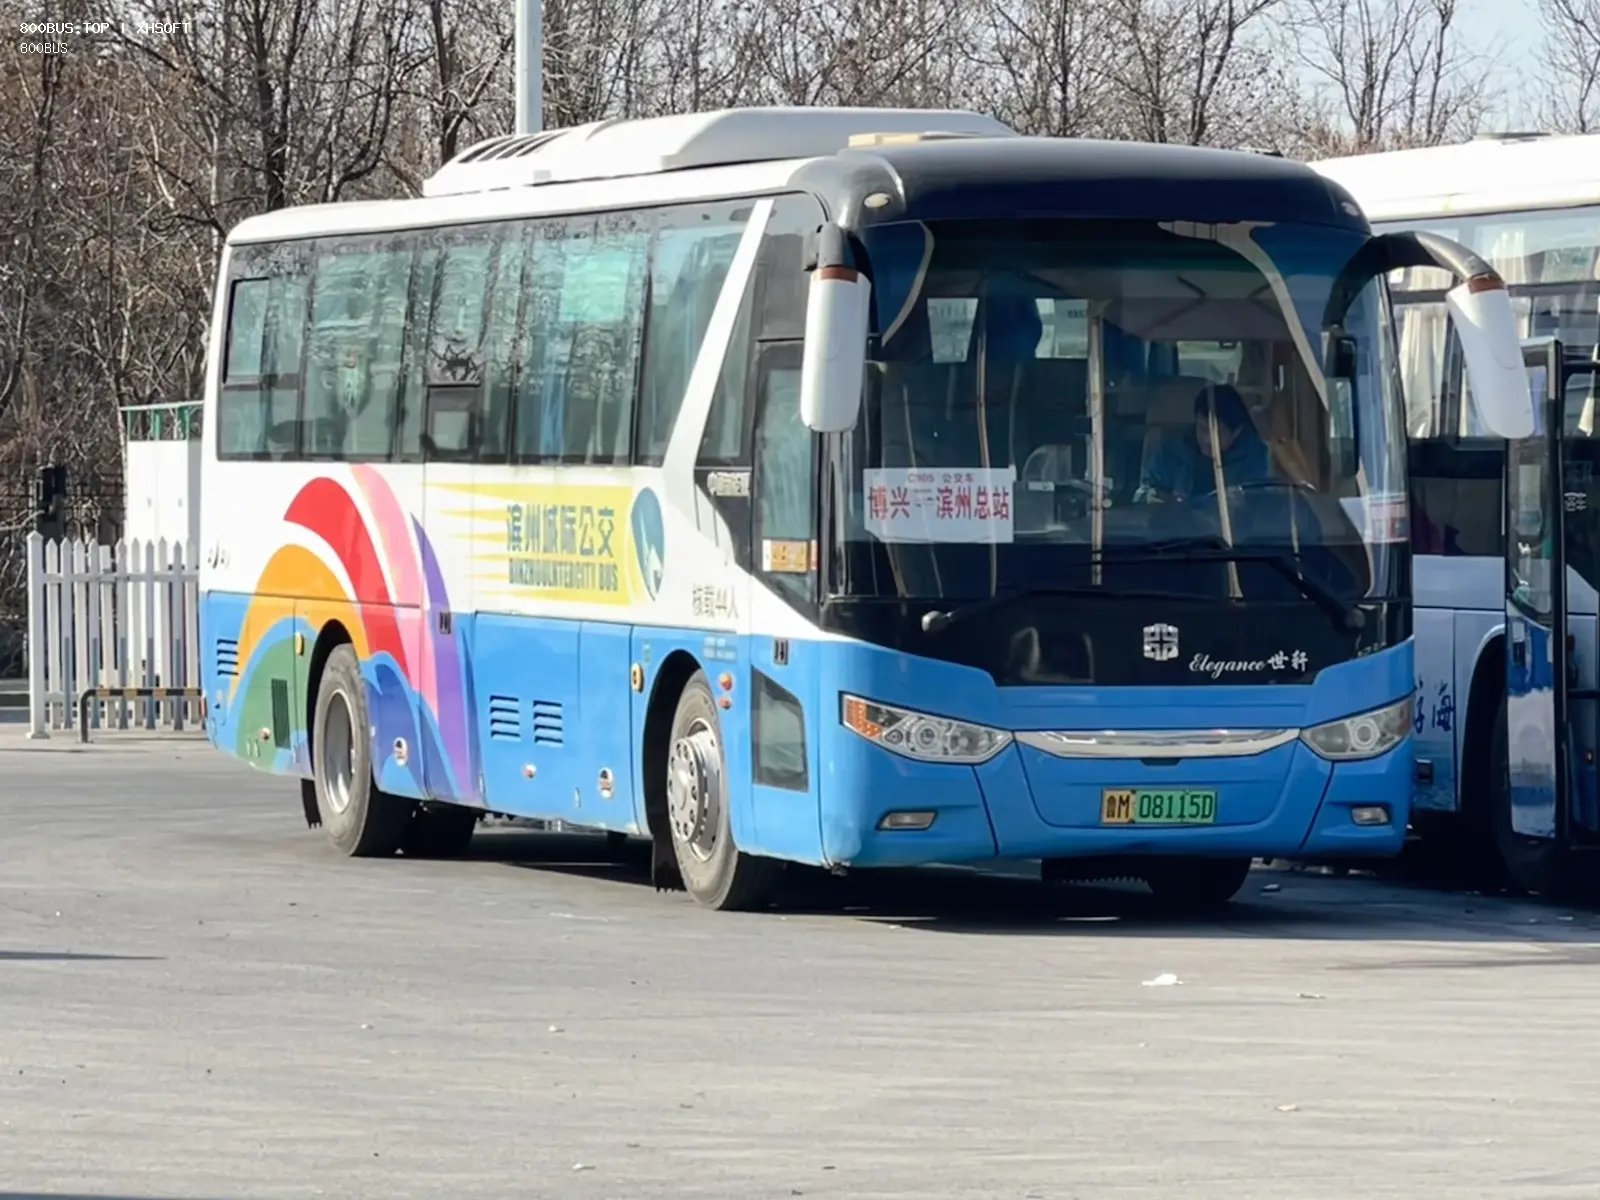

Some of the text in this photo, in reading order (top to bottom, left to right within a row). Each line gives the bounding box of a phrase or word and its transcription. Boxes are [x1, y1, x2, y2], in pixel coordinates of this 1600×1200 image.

[936, 485, 1010, 521] 滨州总站
[1188, 653, 1266, 680] Elegance
